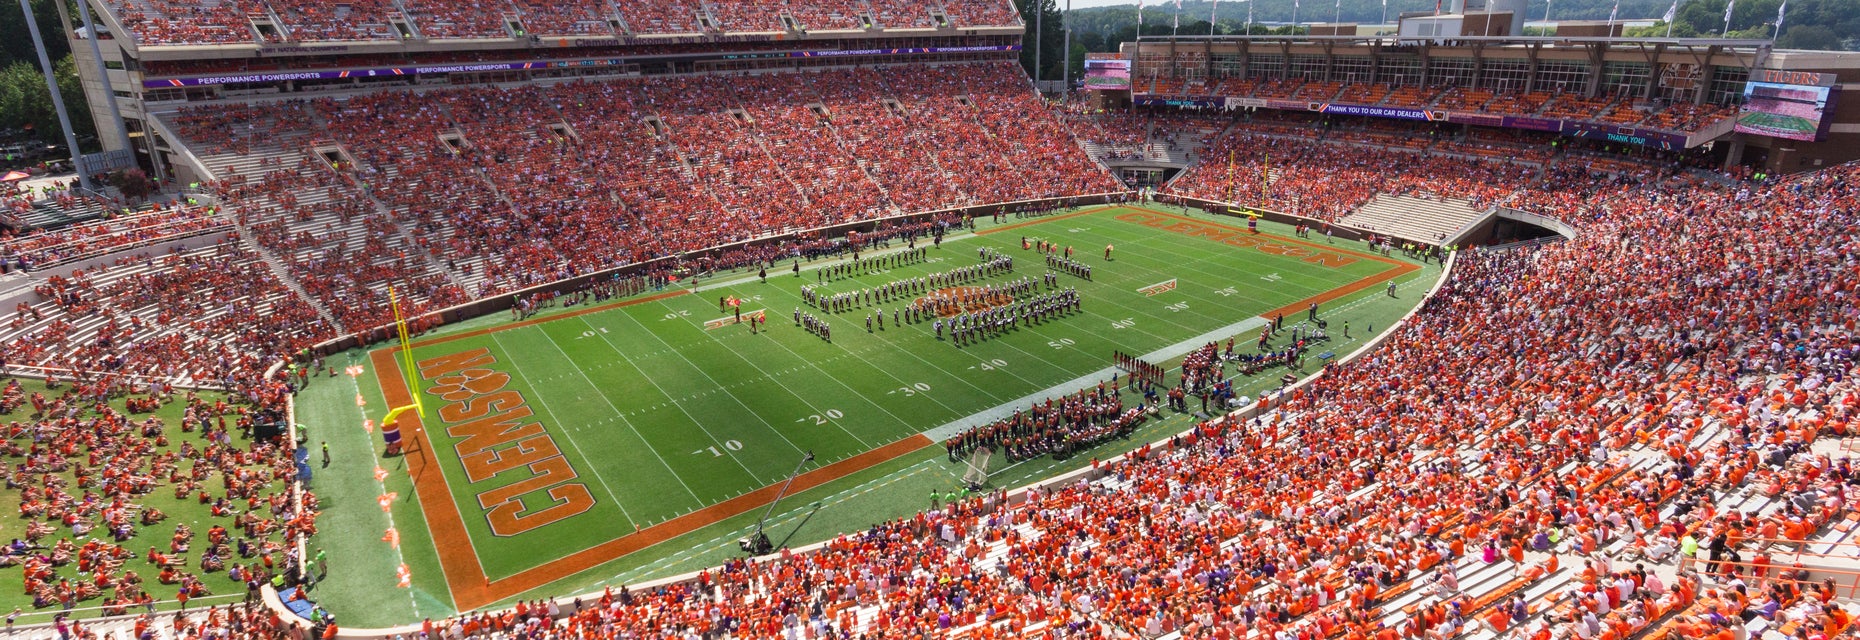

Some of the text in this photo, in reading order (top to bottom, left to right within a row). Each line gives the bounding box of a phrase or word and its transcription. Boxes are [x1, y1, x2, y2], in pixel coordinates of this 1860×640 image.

[575, 34, 770, 47] Clemson Welcomes You To Death Valley
[416, 65, 464, 73] PERFORMANCE
[198, 72, 321, 84] PERFORMANCE POWERSPORTS
[1763, 69, 1821, 85] TIGERS
[1231, 98, 1244, 106] 1981
[1328, 105, 1347, 113] THANK
[1348, 106, 1360, 114] YOU
[1397, 110, 1425, 119] DEALERS
[1607, 133, 1629, 143] THANK
[1629, 135, 1646, 145] YOU!
[1111, 319, 1136, 329] 40
[1047, 338, 1076, 350] 50
[980, 358, 1008, 371] 40
[898, 382, 931, 397] 30
[808, 408, 843, 426] 20
[705, 439, 743, 457] 10
